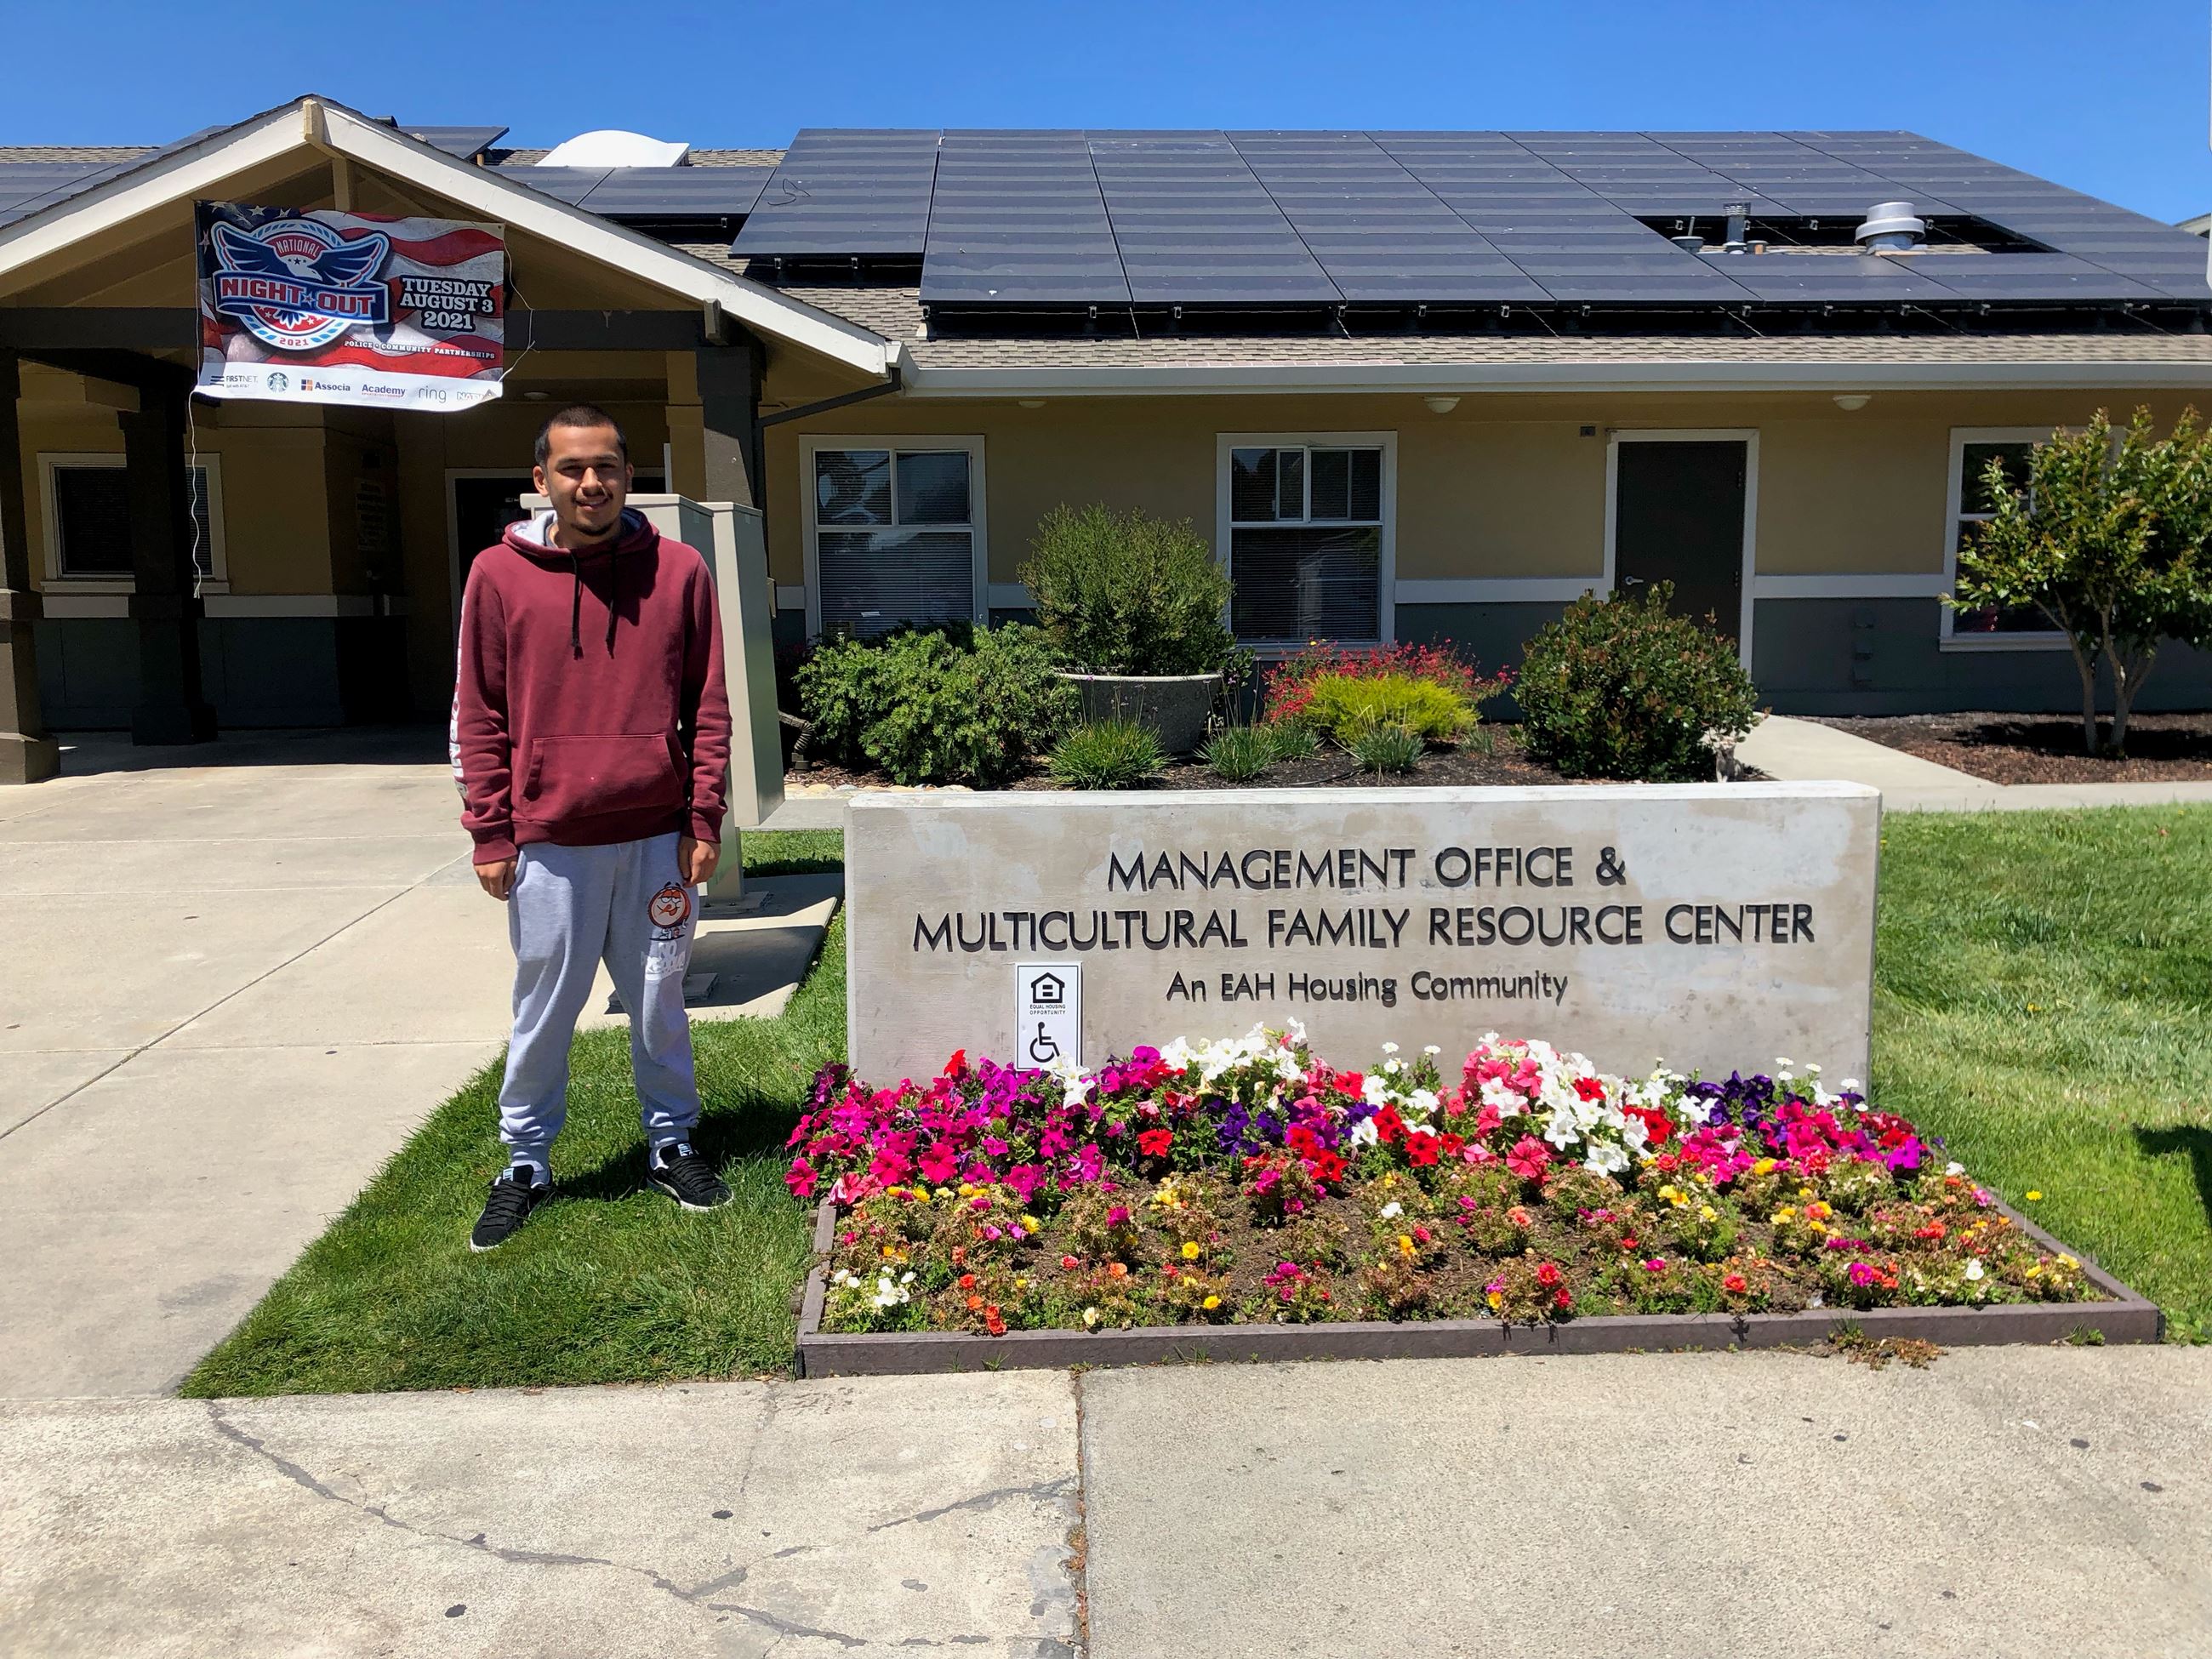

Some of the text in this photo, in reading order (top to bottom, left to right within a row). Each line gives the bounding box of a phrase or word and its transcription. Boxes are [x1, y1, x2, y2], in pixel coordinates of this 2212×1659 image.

[276, 237, 320, 257] NATIONAL
[222, 277, 374, 315] NIGHT OUT
[402, 277, 491, 297] TUESDAY
[400, 293, 493, 313] AUGUST 3
[424, 311, 473, 329] 2021
[279, 337, 309, 346] 2021
[344, 340, 495, 359] POLICE COMMUNITY PARTNERSHIPS
[314, 381, 351, 392] Associa
[362, 384, 406, 397] Academy
[418, 385, 447, 403] ring
[1107, 845, 1627, 892] MANAGEMENT OFFICE &
[913, 904, 1815, 952] MULTICULTURAL FAMILY RESOURCE CENTER
[1166, 969, 1569, 1007] An EAH Housing Community
